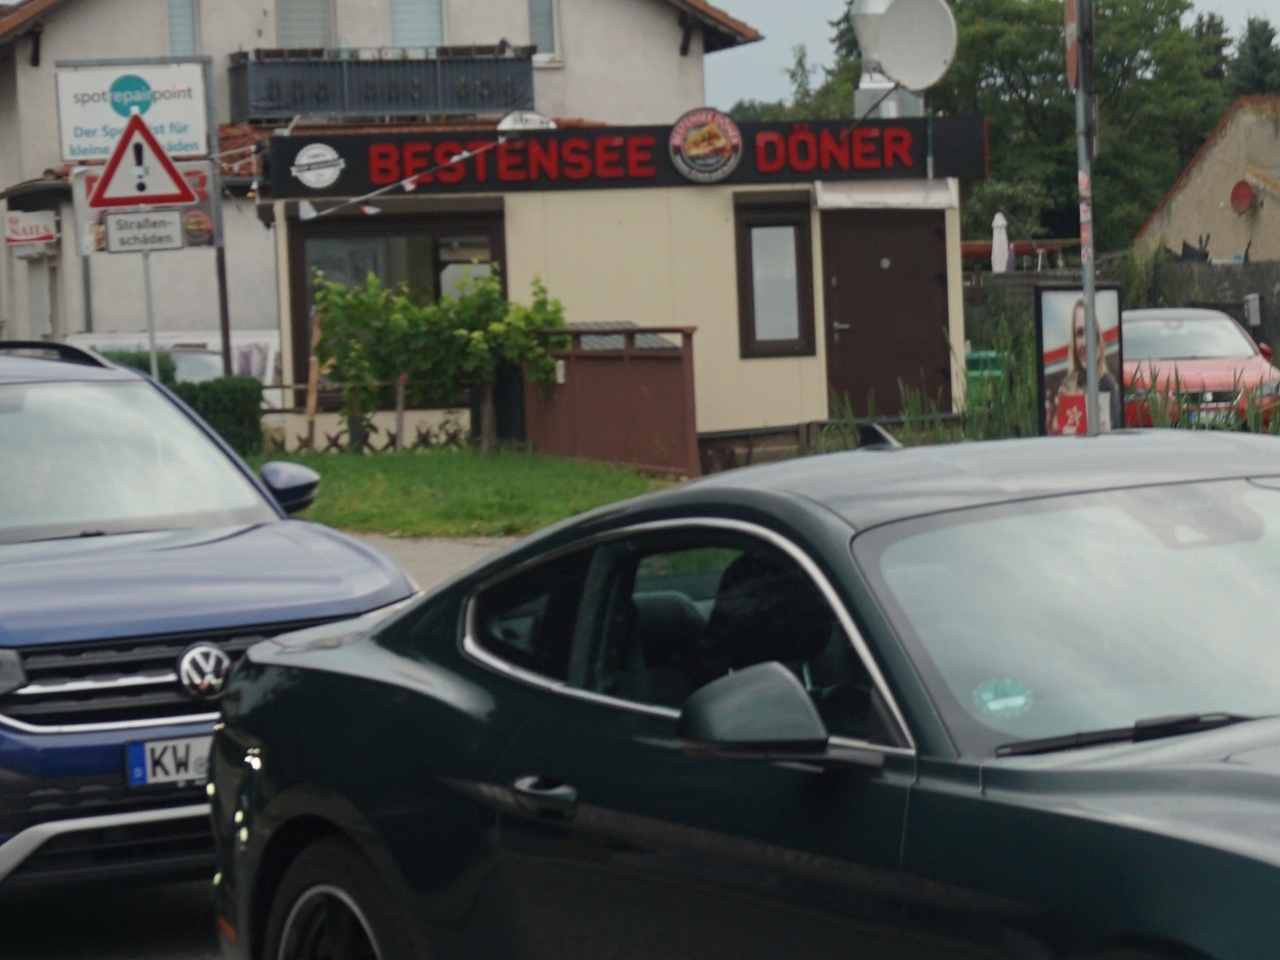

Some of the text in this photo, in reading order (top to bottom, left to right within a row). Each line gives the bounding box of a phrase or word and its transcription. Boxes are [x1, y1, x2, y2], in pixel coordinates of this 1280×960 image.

[73, 126, 98, 138] Der
[169, 121, 189, 135] für
[69, 144, 110, 156] kleine
[368, 136, 657, 185] BESTENSEE
[755, 122, 913, 173] DÖNER
[9, 224, 52, 237] NAILS
[115, 218, 174, 231] Straßen-
[118, 234, 173, 246] schäden
[150, 743, 191, 777] KW
